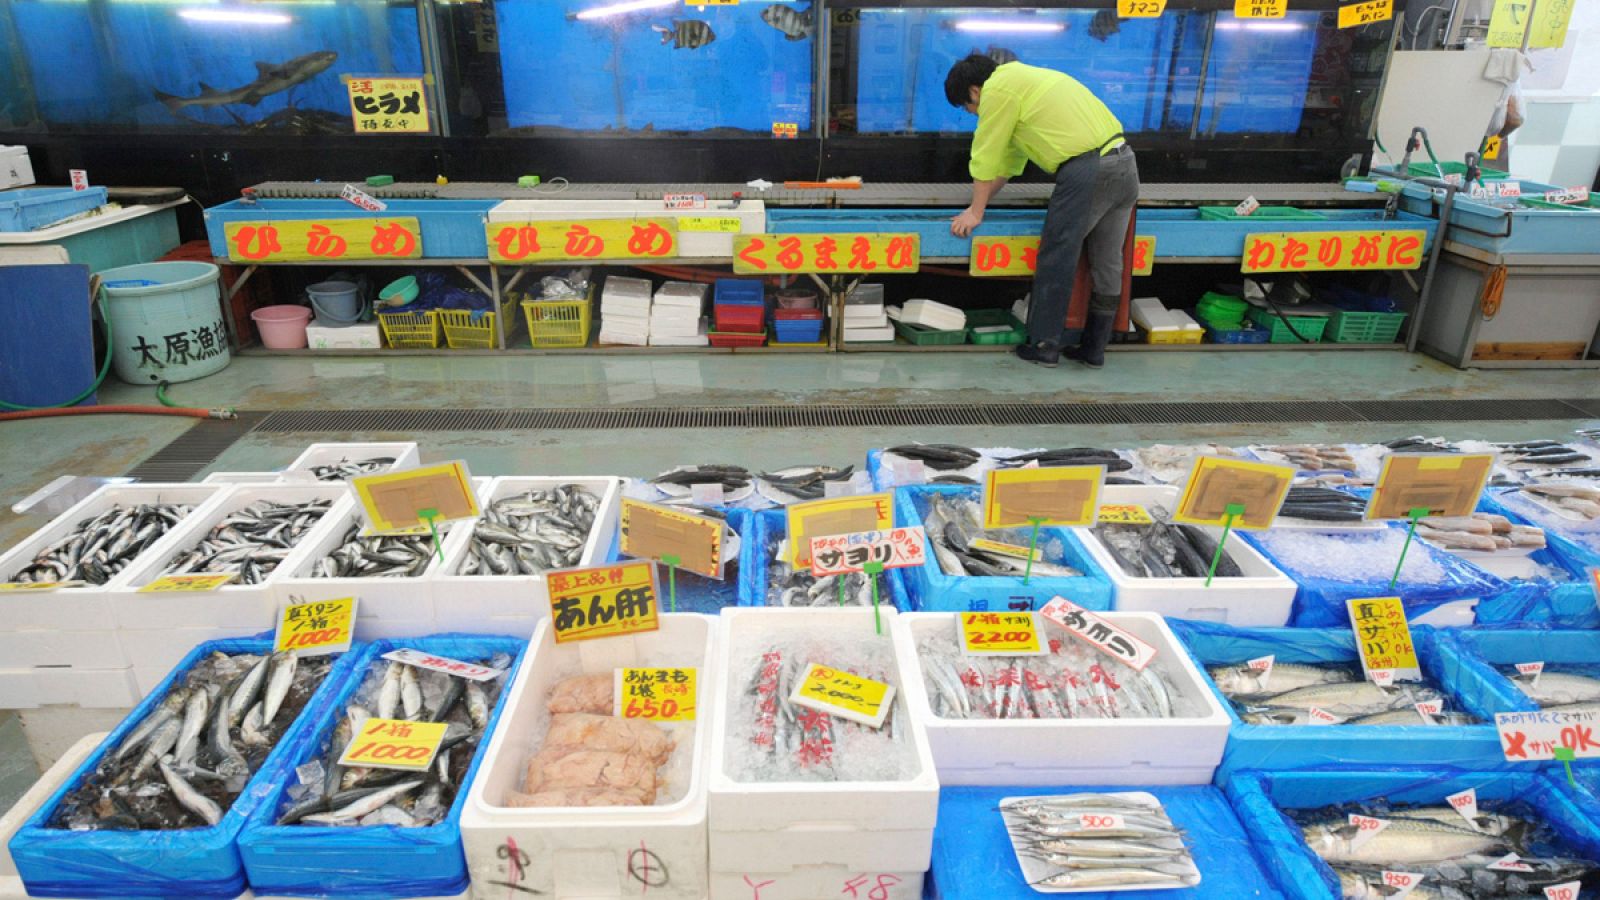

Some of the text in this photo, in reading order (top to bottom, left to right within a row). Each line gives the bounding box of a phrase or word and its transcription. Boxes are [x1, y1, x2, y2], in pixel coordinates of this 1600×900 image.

[353, 91, 420, 115] ヒラメ
[232, 223, 415, 260] ひらめ
[499, 223, 672, 260] ひらめ
[739, 236, 913, 271] くるまえび
[1248, 235, 1421, 270] わたりがに
[816, 543, 892, 568] サヨリ
[552, 585, 655, 632] あん肝
[968, 631, 1032, 645] 2200
[1082, 814, 1114, 827] 500
[1385, 872, 1411, 886] 950
